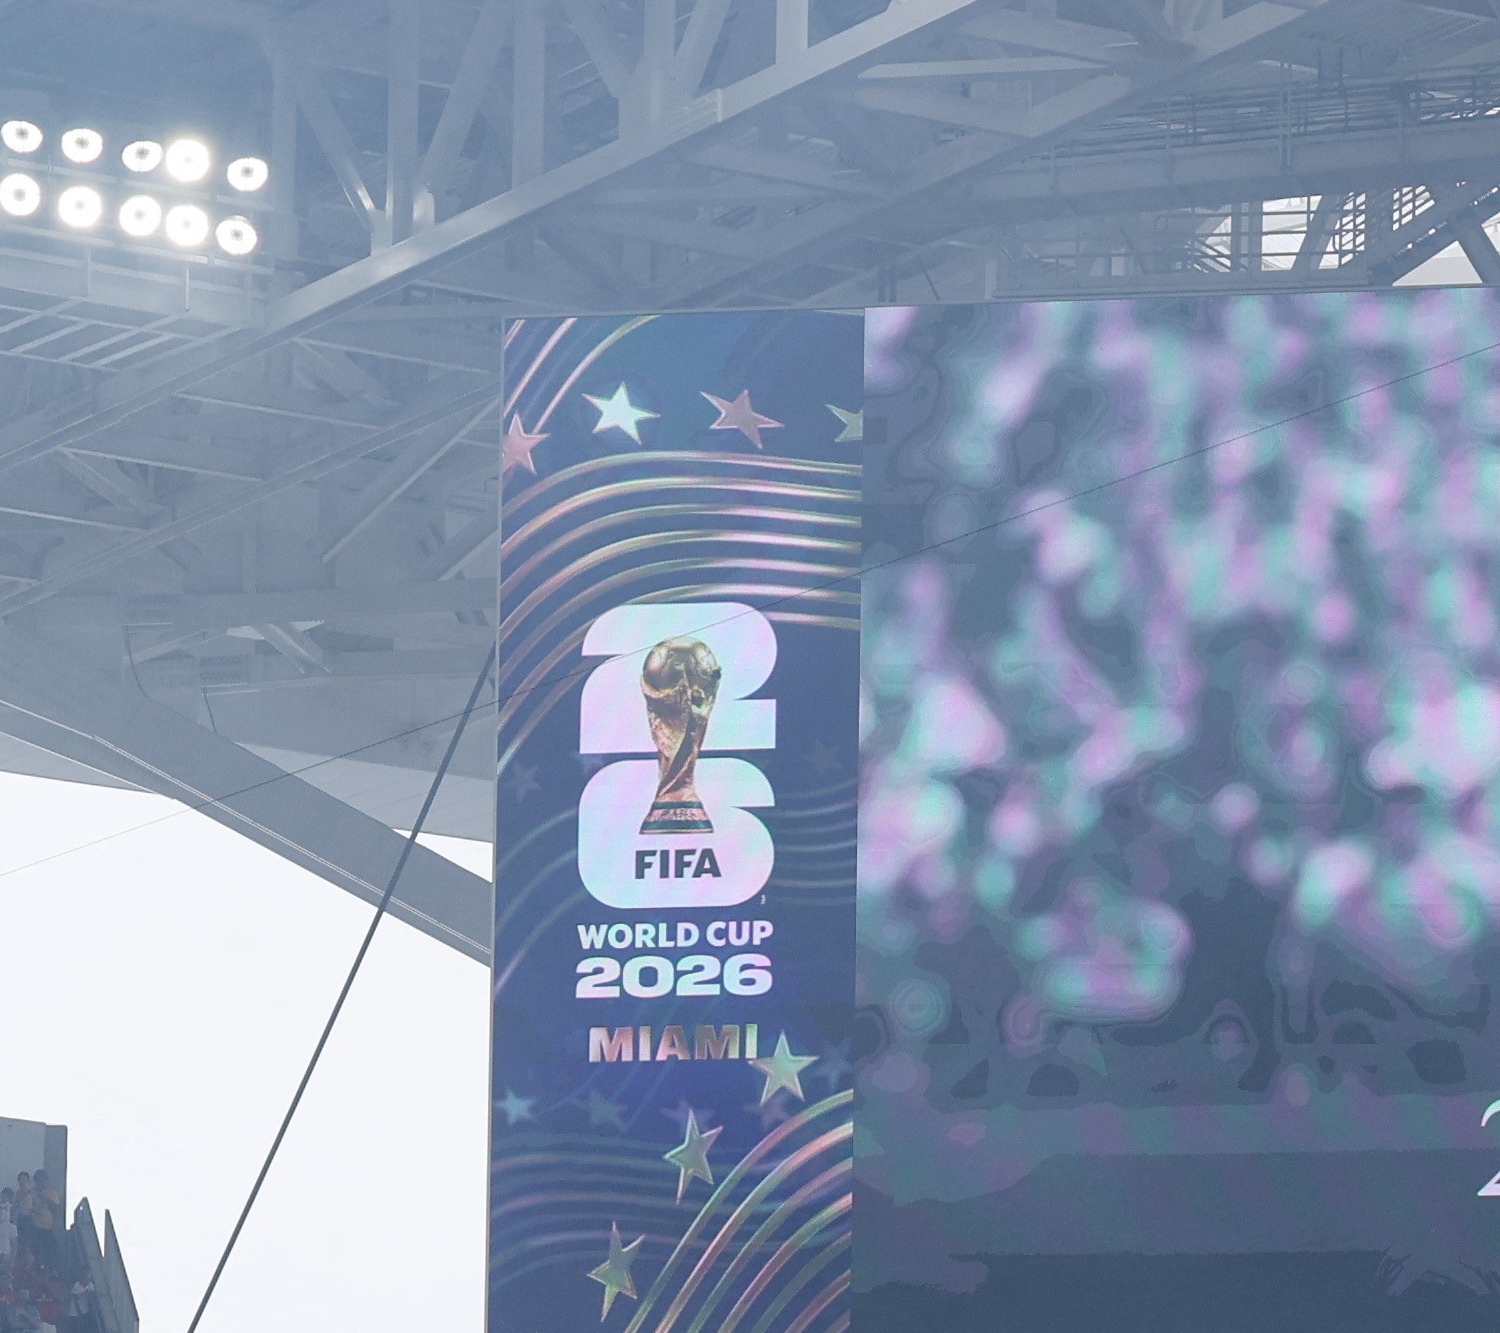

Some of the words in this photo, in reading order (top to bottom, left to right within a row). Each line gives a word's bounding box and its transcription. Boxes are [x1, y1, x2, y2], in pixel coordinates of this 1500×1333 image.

[634, 847, 722, 880] FIFA
[577, 922, 699, 950] WORLD
[706, 920, 774, 947] CUP
[575, 953, 773, 999] 2026
[588, 1023, 759, 1064] MIAMI
